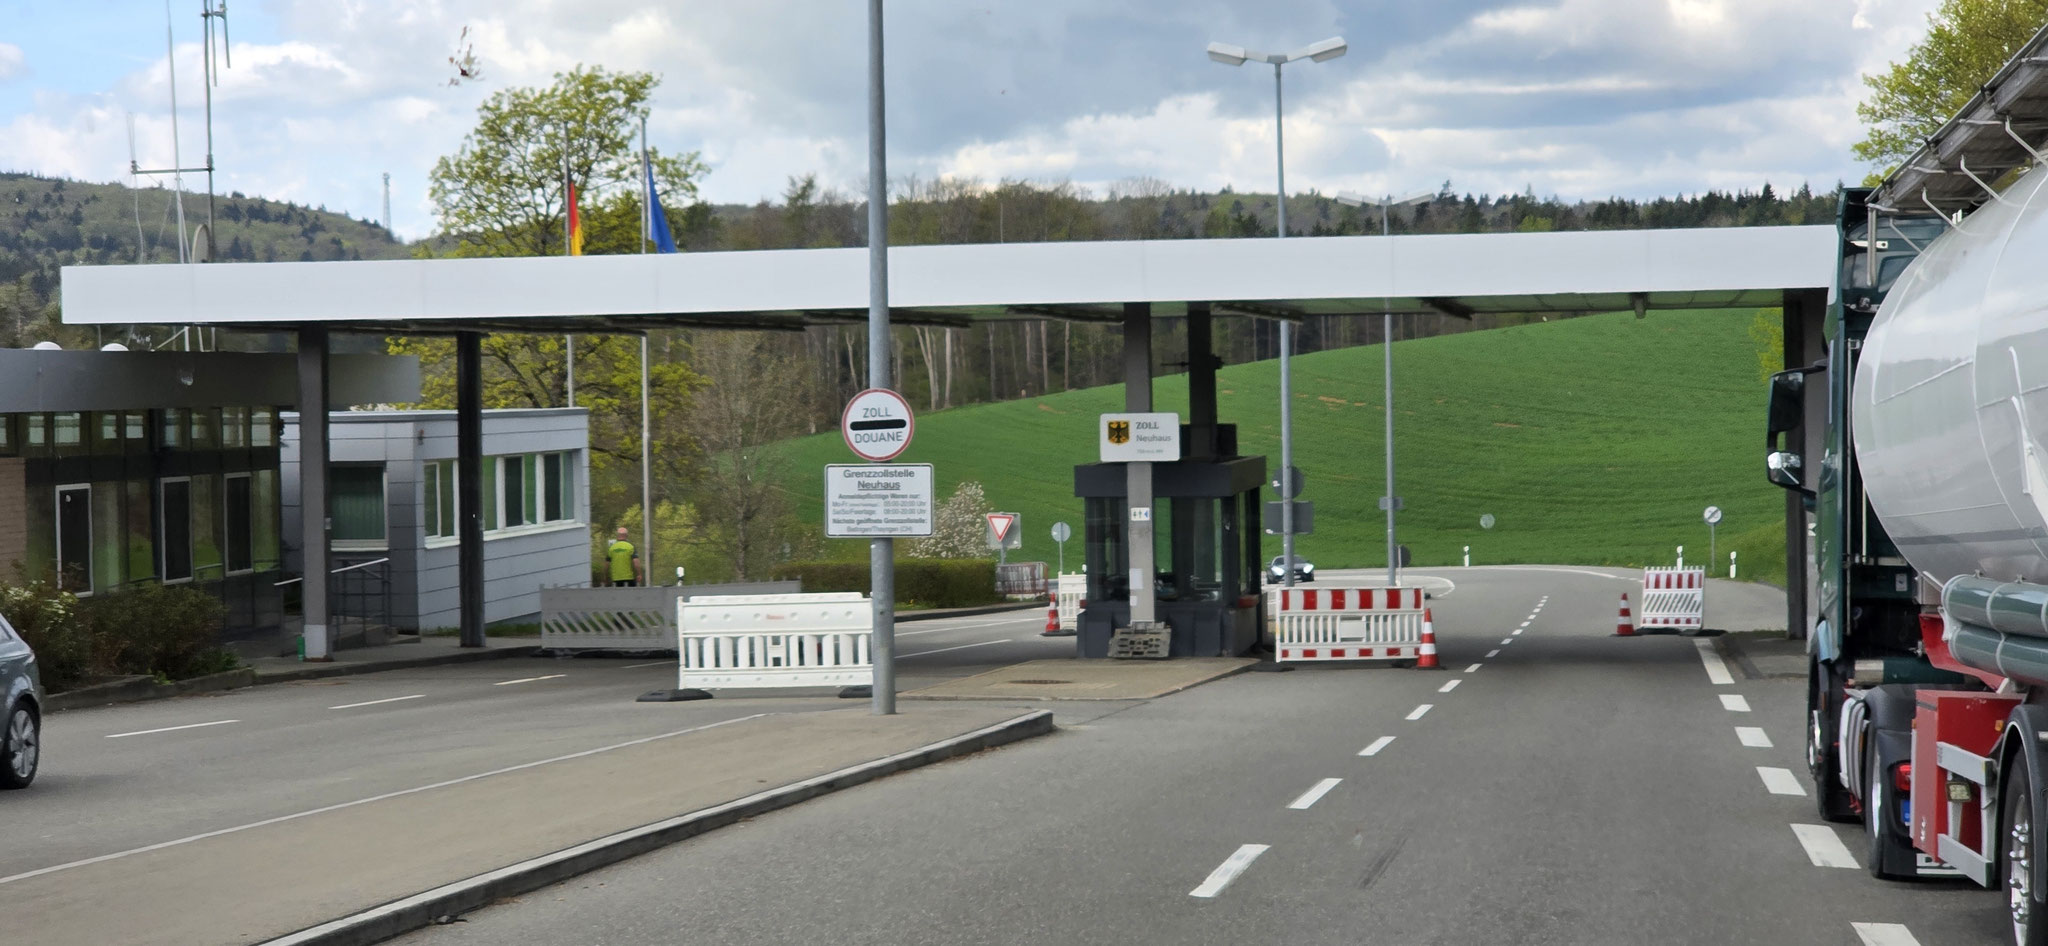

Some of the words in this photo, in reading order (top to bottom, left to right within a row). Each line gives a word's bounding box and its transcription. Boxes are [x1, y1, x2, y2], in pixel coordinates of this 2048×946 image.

[862, 407, 892, 418] ZOLL
[1135, 421, 1159, 430] ZOLL
[854, 431, 904, 444] DOUANE
[1136, 434, 1172, 442] Neuhaus
[843, 469, 915, 478] Grenzzollstelle
[857, 480, 901, 490] Neuhaus
